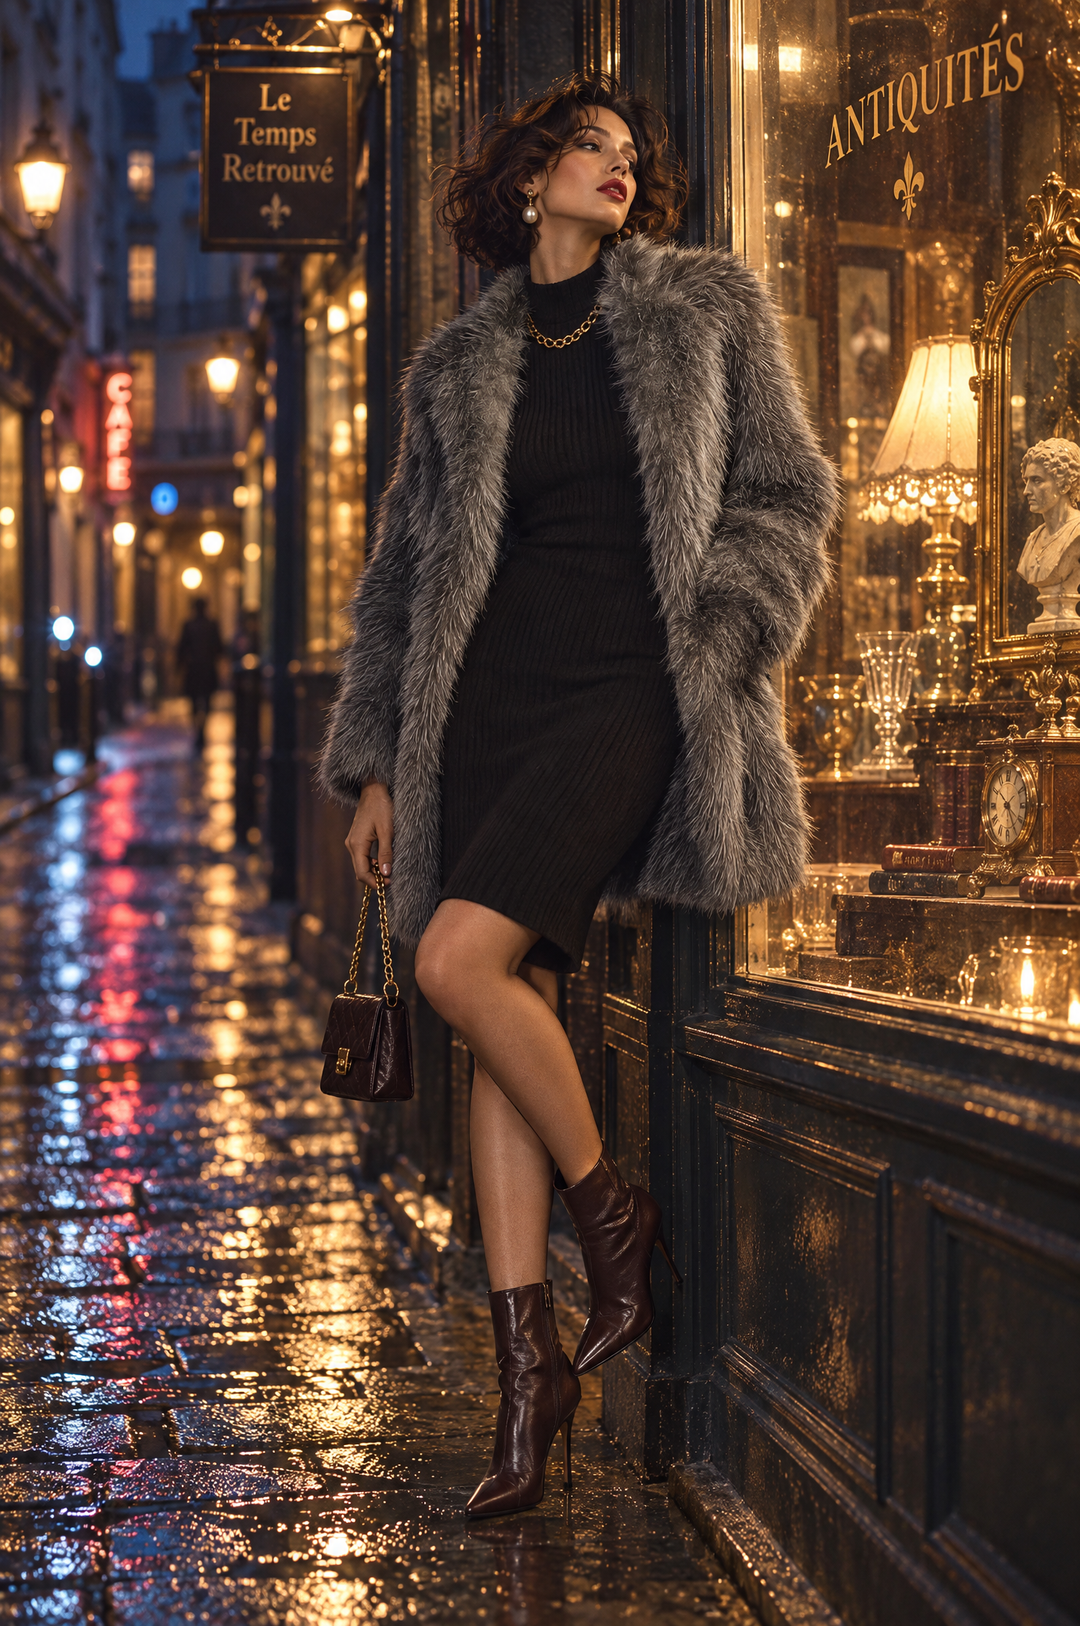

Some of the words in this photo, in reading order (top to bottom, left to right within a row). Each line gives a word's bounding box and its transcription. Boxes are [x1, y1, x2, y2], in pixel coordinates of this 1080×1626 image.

[258, 83, 292, 111] Le
[825, 23, 1024, 169] ANTIQUITÉS
[234, 117, 317, 154] Temps
[222, 153, 334, 183] Retrouvé
[105, 372, 133, 491] CAFE
